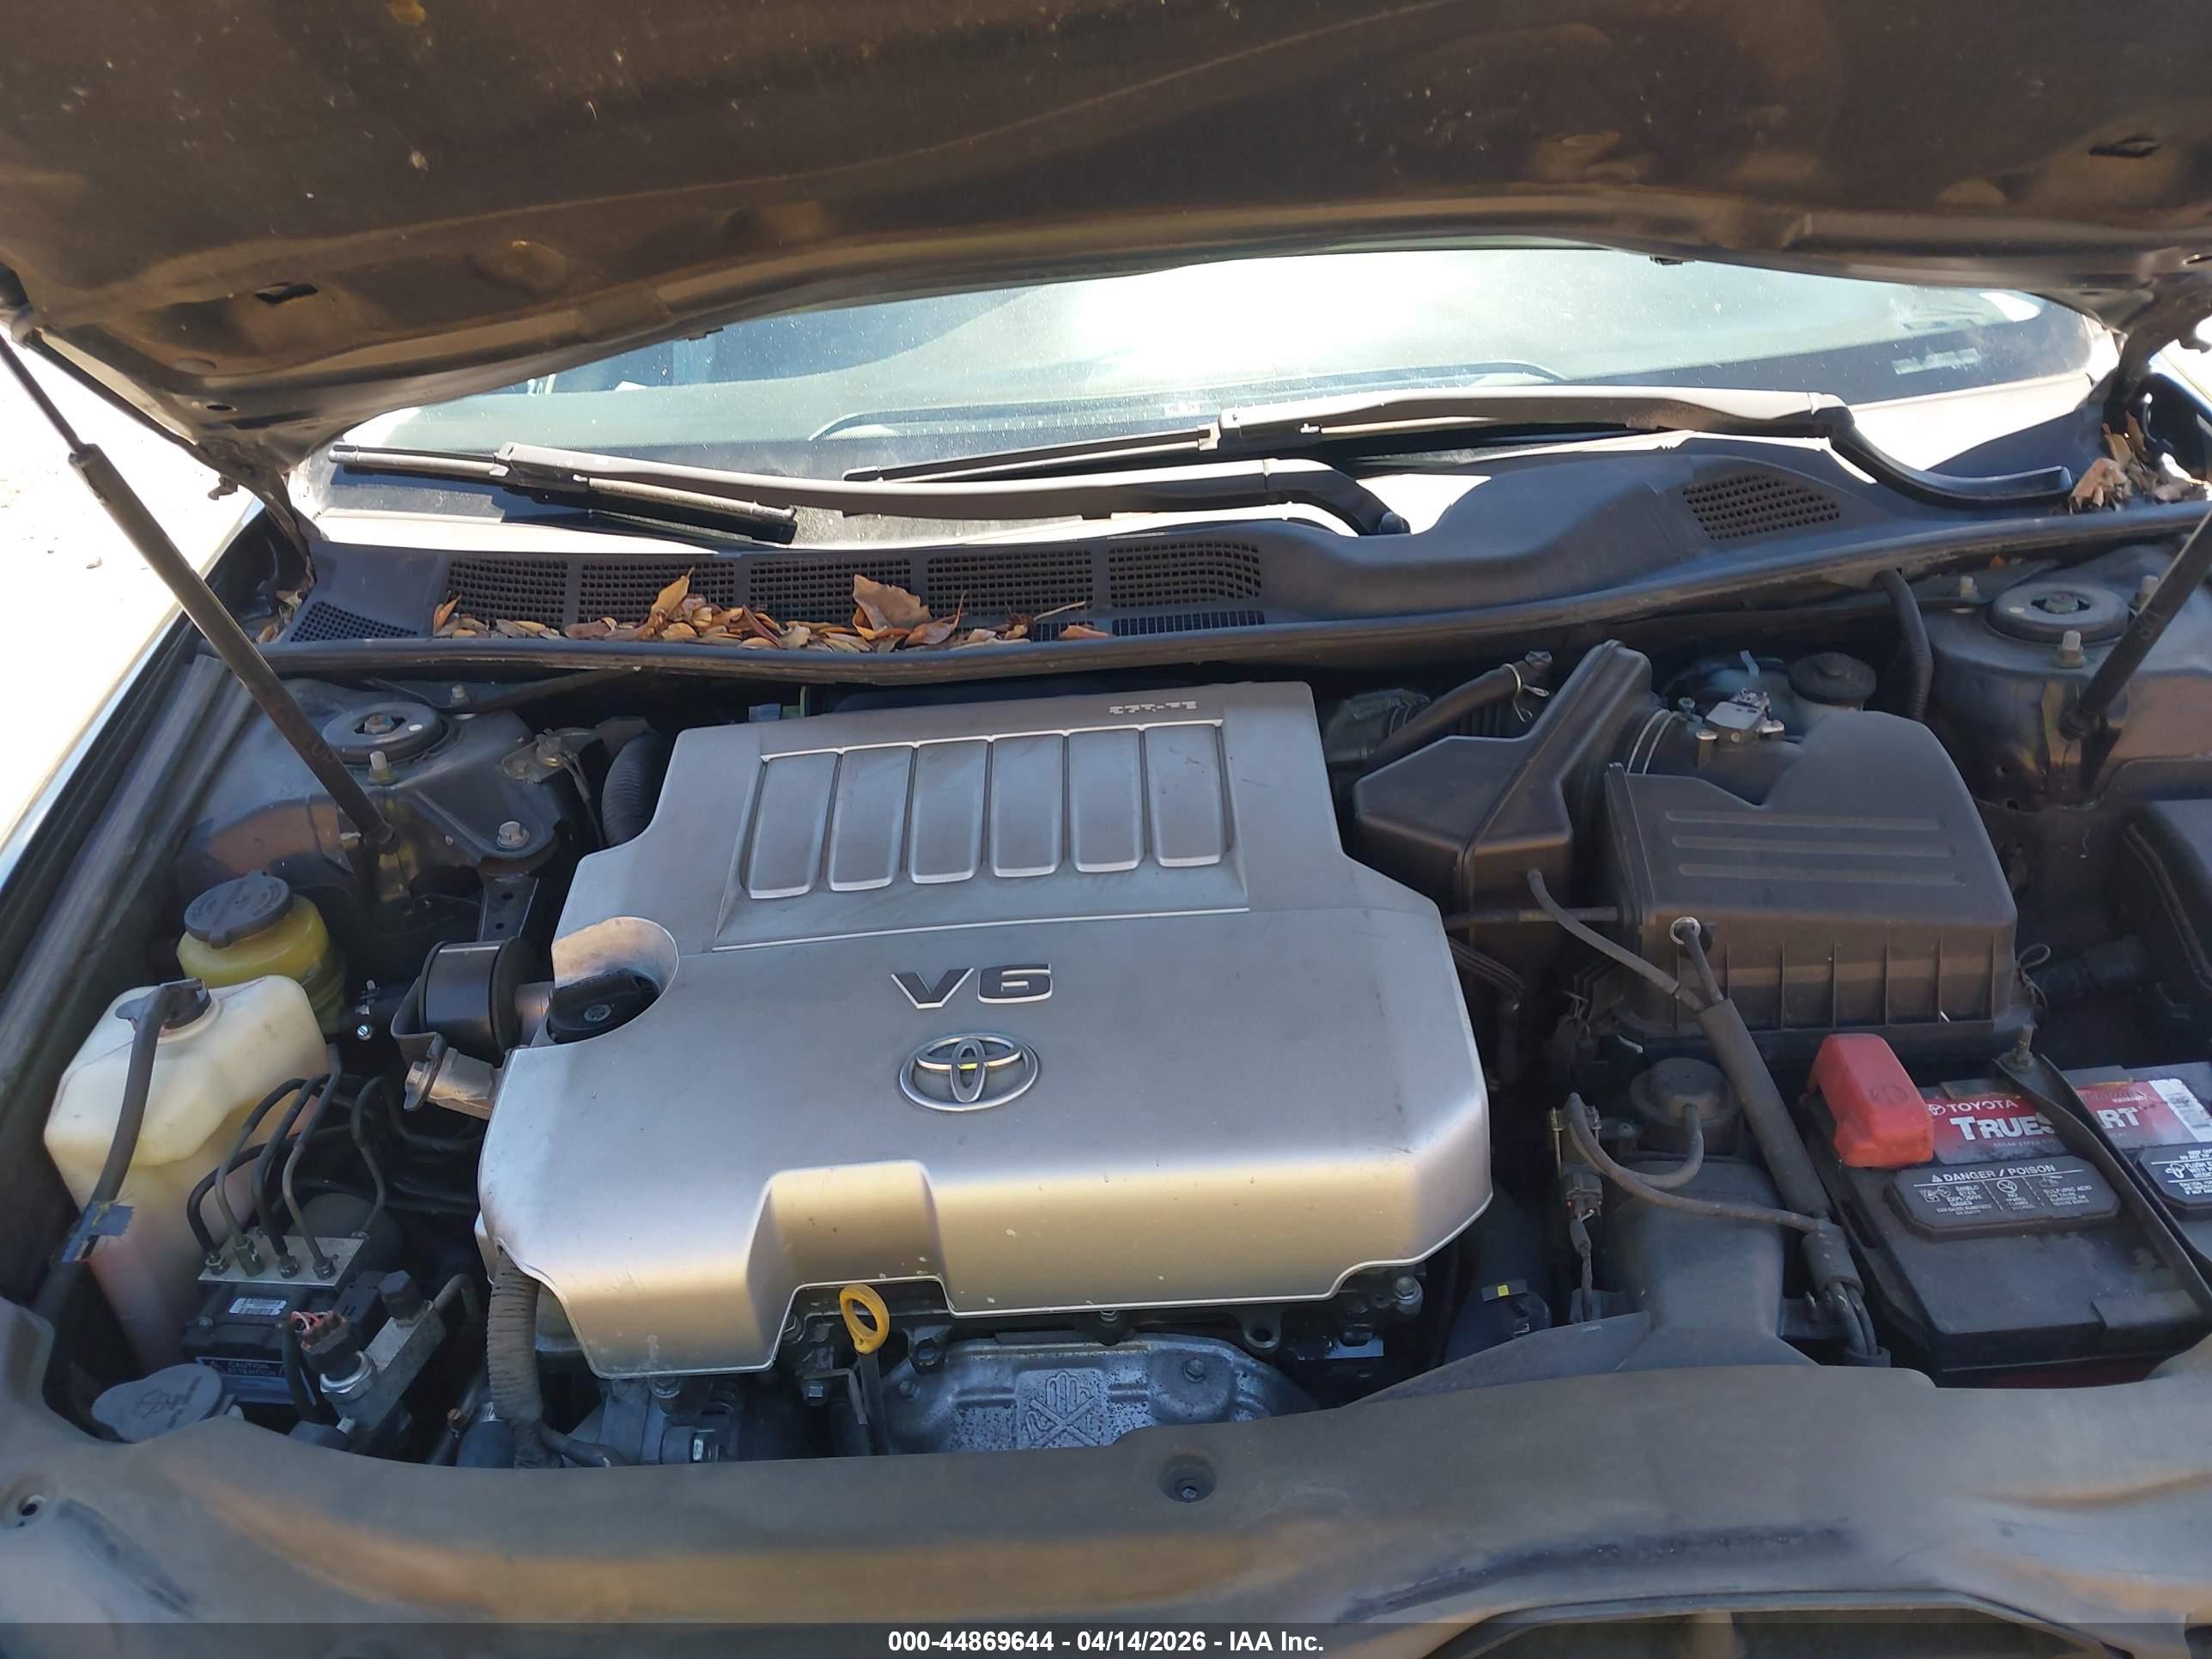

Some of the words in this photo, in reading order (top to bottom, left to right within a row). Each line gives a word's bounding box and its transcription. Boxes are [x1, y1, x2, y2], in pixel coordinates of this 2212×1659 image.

[890, 963, 1053, 1009] V6
[1946, 1100, 2019, 1113] TOYOTA
[1942, 1170, 1996, 1182] DANGER
[2008, 1164, 2056, 1176] POISON
